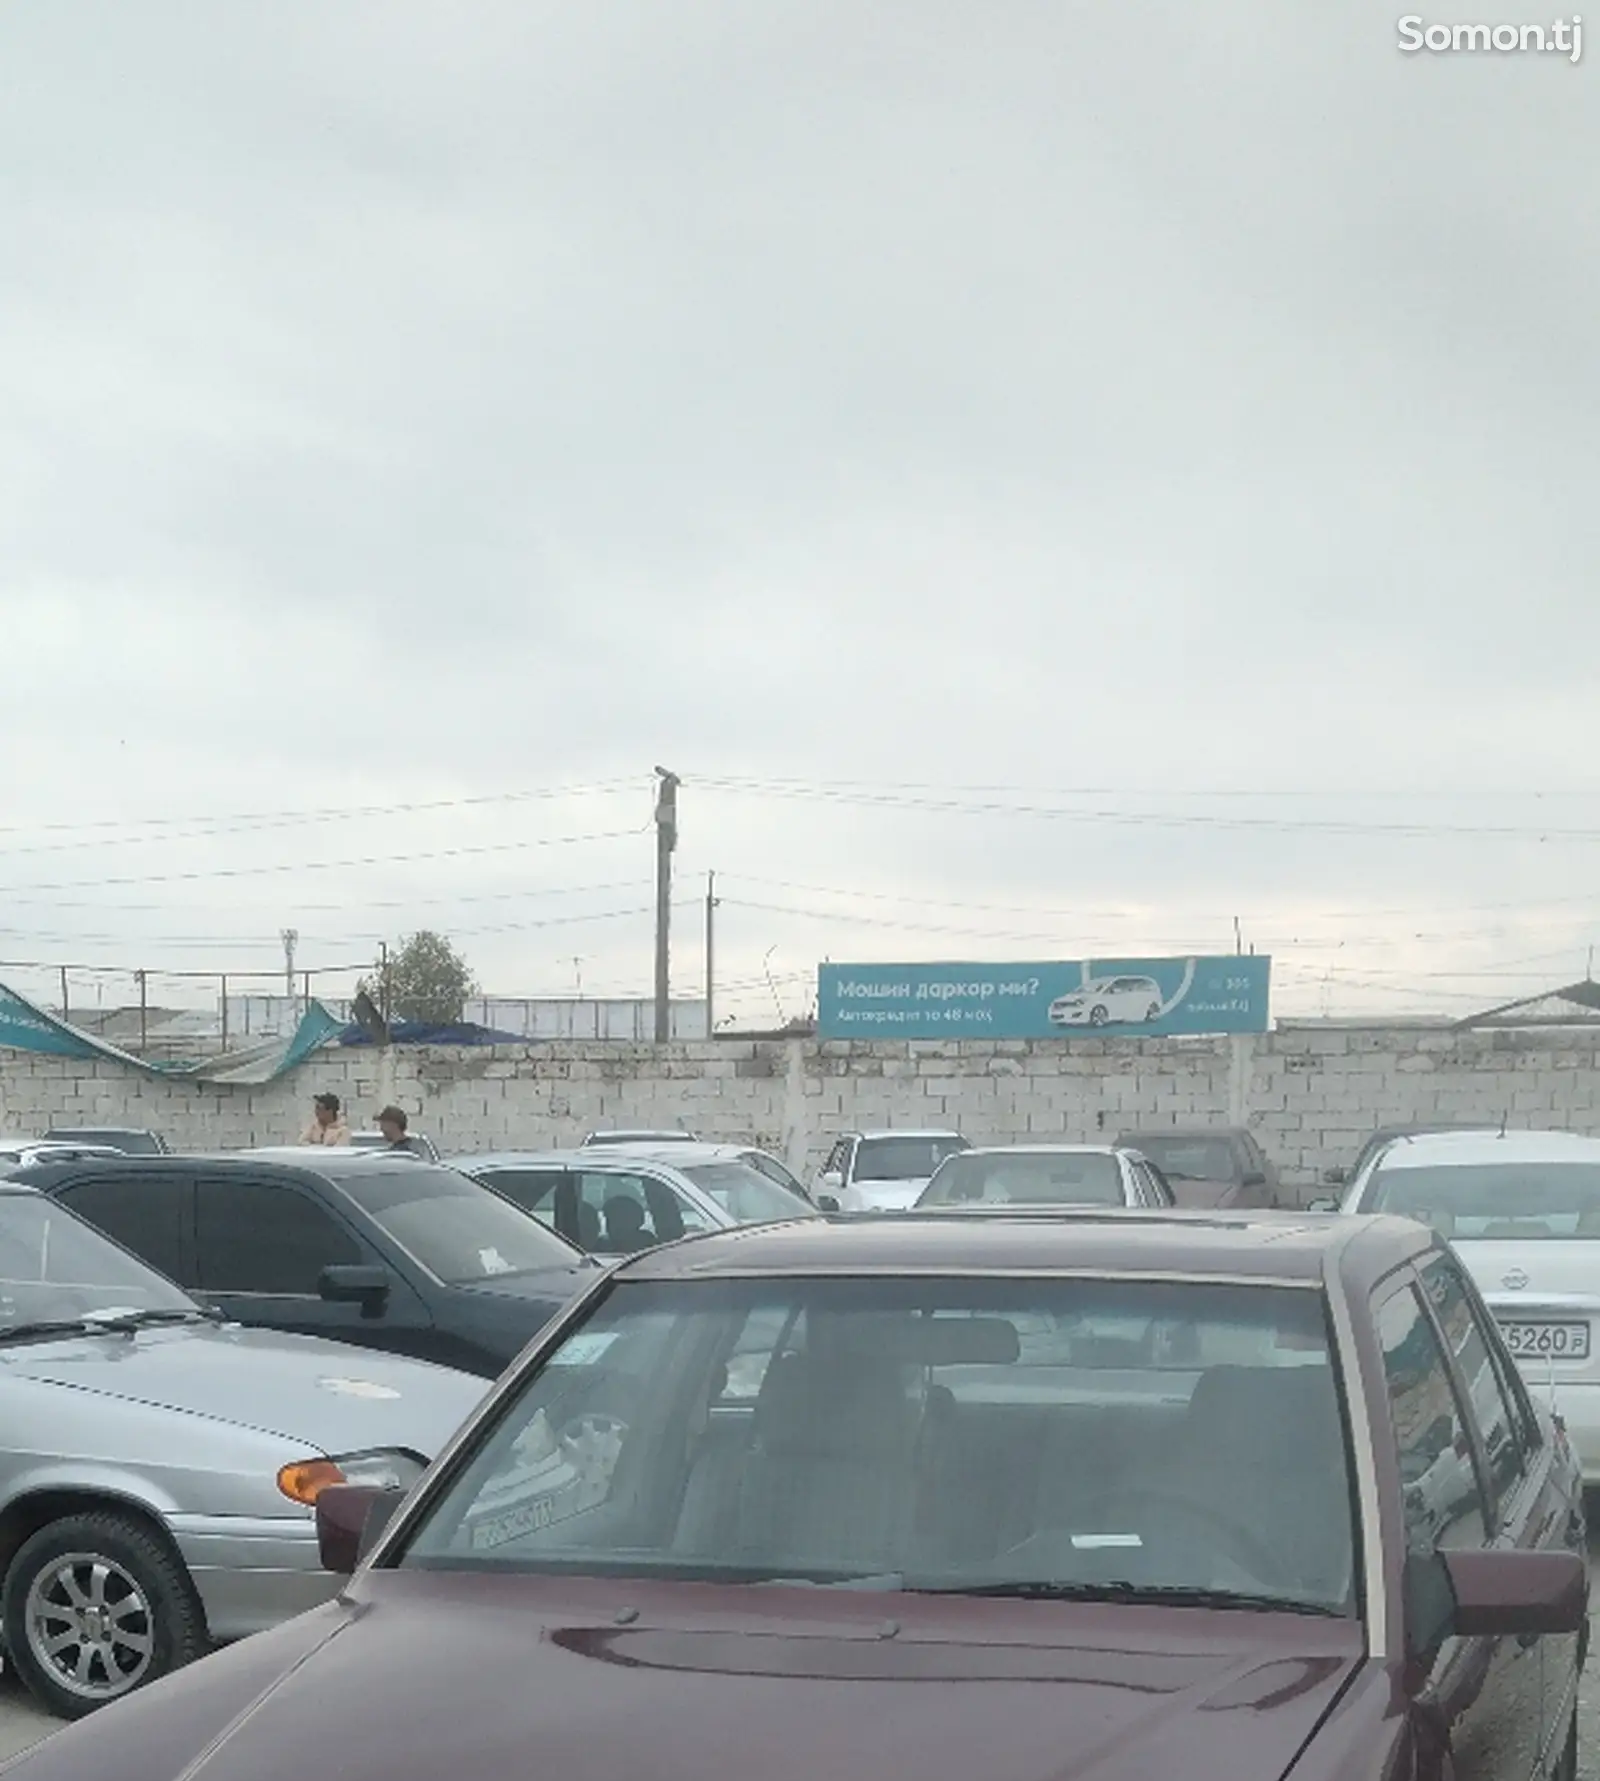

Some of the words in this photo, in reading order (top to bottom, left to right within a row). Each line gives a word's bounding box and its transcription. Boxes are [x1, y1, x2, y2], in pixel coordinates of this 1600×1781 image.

[837, 981, 911, 998] Мошин
[916, 982, 995, 1001] даркор
[999, 977, 1040, 998] ми?
[1501, 1326, 1567, 1352] 5260
